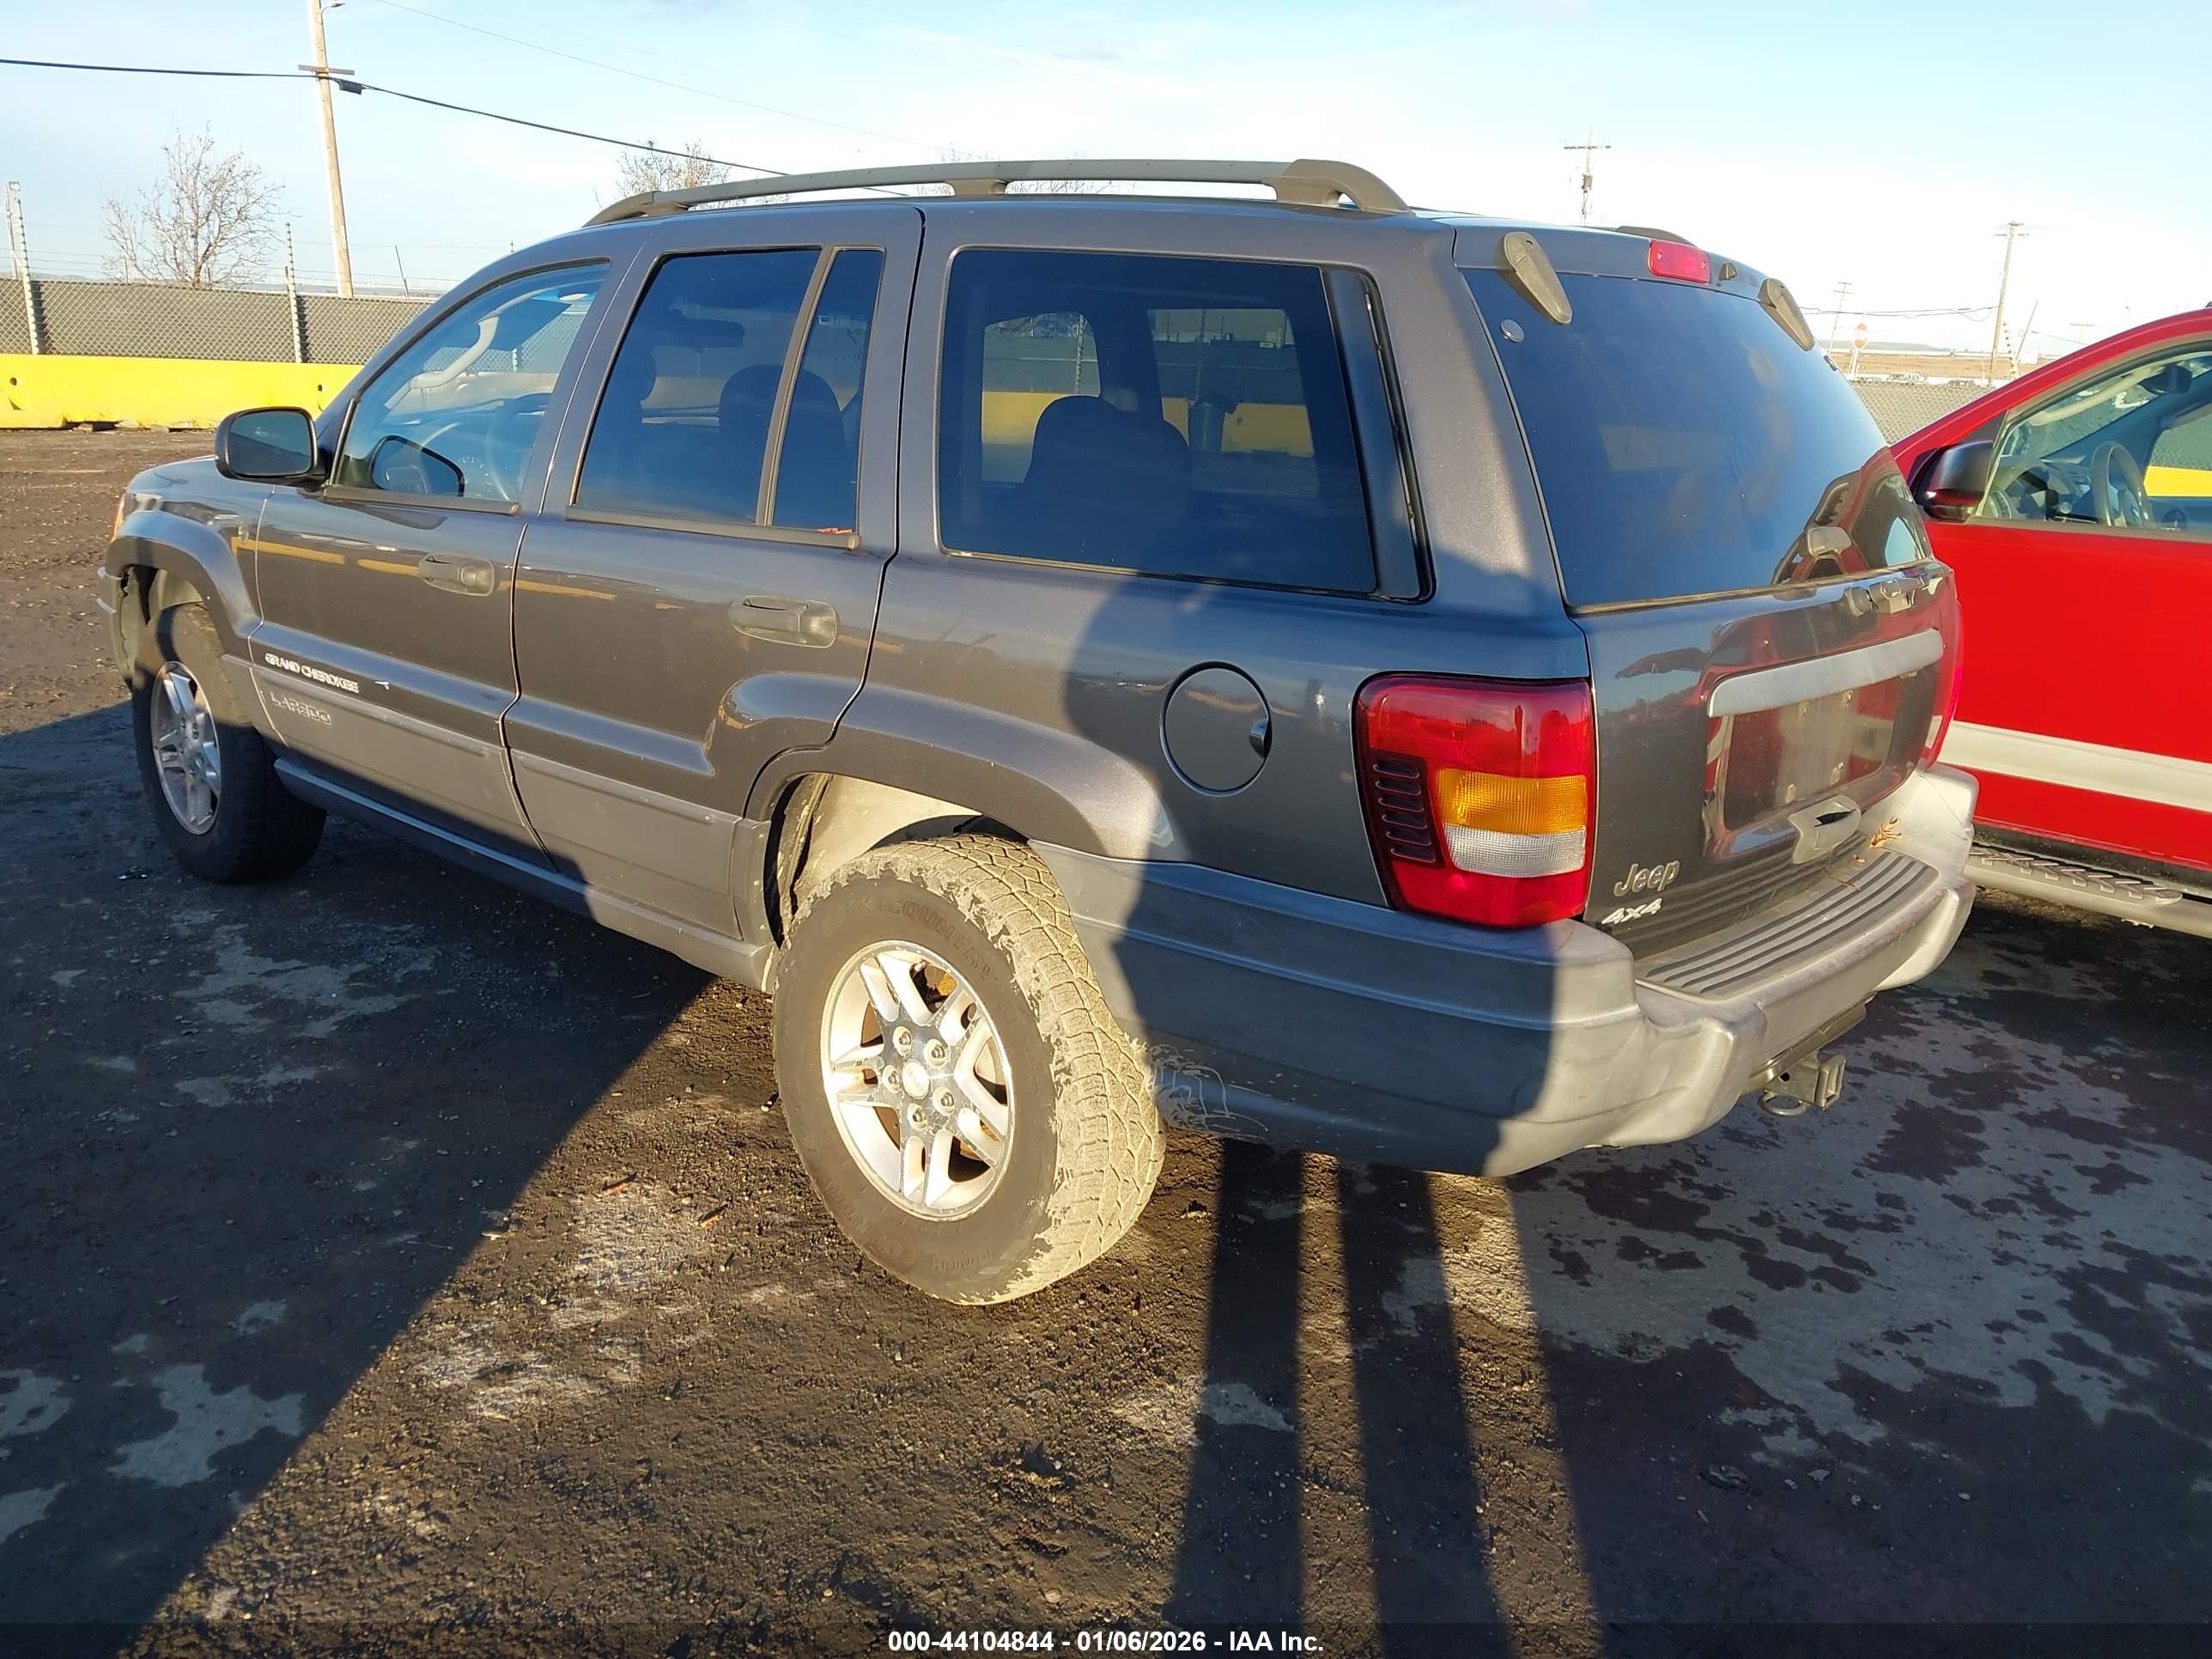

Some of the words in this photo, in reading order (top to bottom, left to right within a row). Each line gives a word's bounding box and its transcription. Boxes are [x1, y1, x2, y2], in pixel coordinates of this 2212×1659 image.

[264, 652, 301, 674] GRAND
[301, 665, 360, 694] CHEROKEE
[270, 690, 332, 726] LAREDO
[1613, 860, 1680, 897] Jeep
